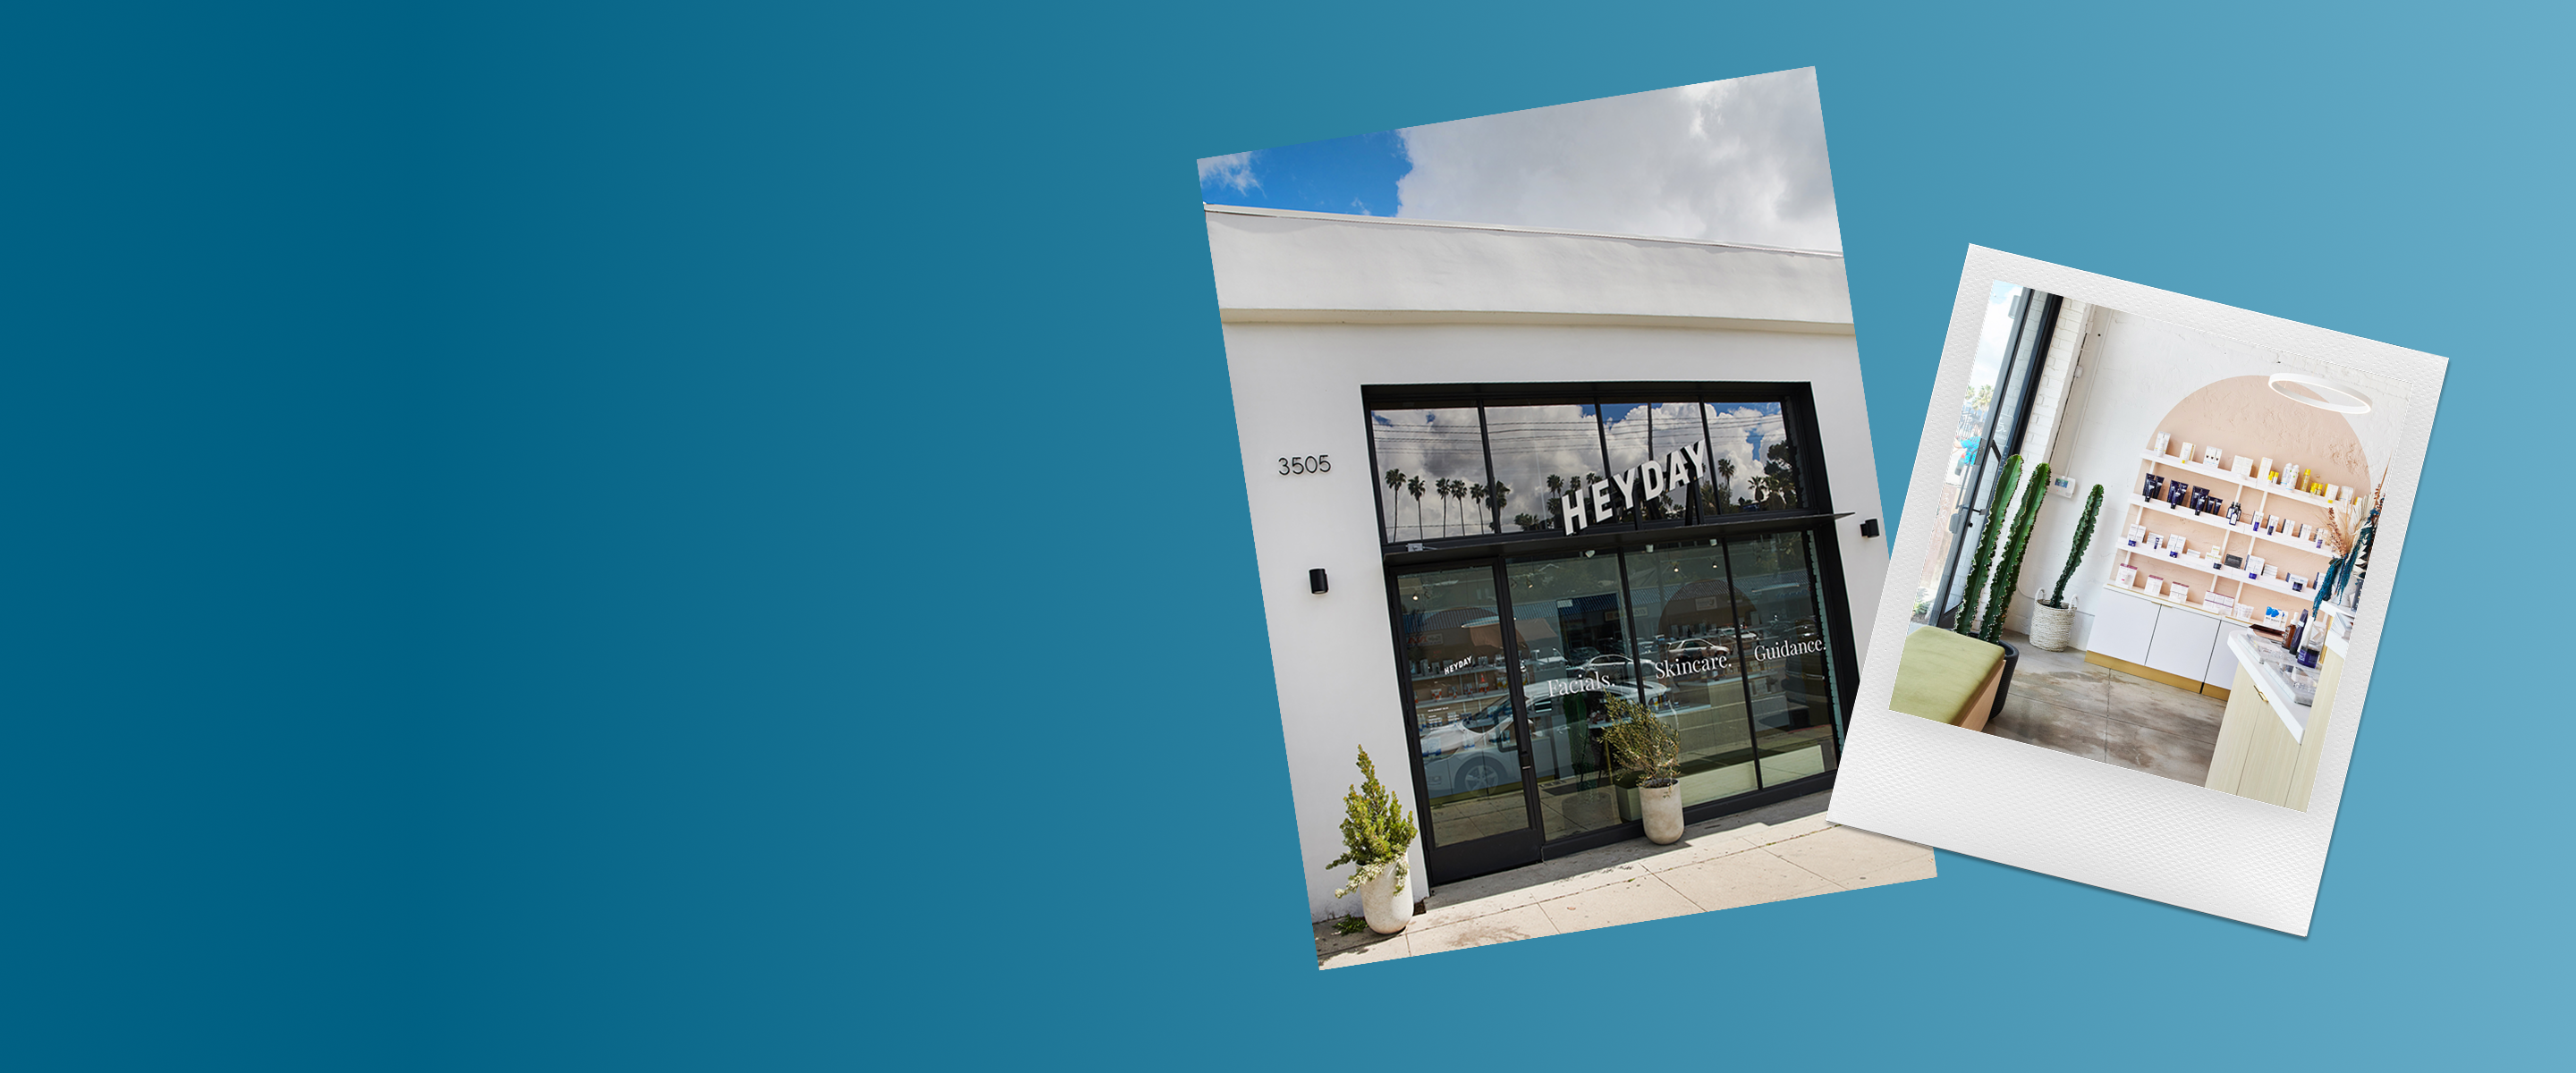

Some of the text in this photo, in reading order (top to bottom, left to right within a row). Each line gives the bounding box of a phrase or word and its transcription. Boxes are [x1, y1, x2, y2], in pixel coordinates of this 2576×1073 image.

[1277, 453, 1332, 476] 3505
[1561, 438, 1706, 536] HEYDAY
[1444, 655, 1473, 676] HEYDAY
[1547, 638, 1826, 697] Facials. Skincare. Guidance.
